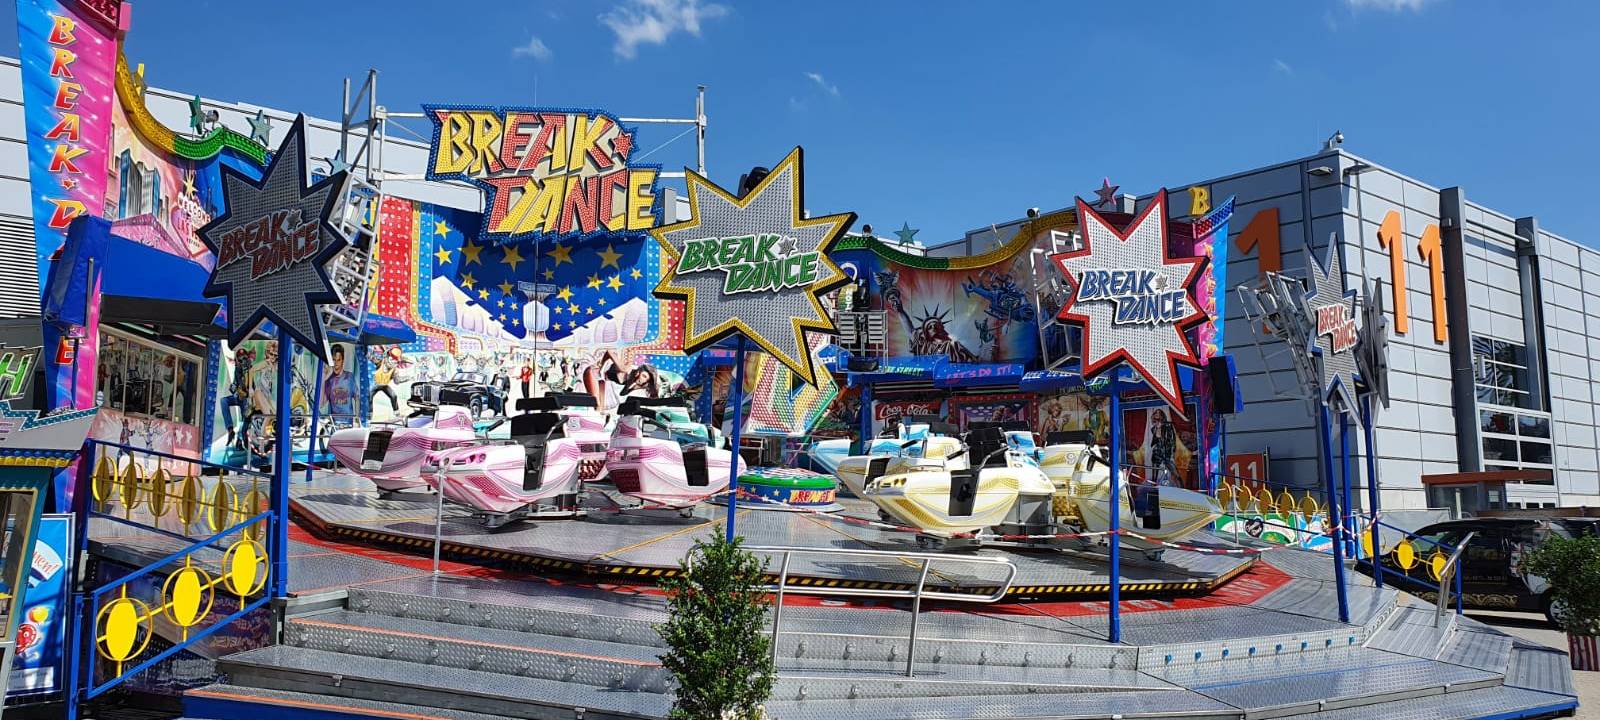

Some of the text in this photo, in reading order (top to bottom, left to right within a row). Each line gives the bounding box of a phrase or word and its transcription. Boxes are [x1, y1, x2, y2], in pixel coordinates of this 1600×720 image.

[45, 15, 89, 174] BREAK
[434, 111, 614, 174] BREAK
[480, 168, 657, 235] DANCE
[216, 209, 291, 270] BREAK
[248, 218, 320, 281] DANCE
[676, 233, 781, 274] BREAK
[722, 251, 820, 294] DANCE
[1077, 269, 1157, 301] BREAK
[1377, 210, 1448, 344] 11
[1114, 289, 1187, 324] DANCE
[1318, 303, 1346, 336] BREAK
[1331, 318, 1357, 353] DANCE
[1230, 461, 1258, 489] 11
